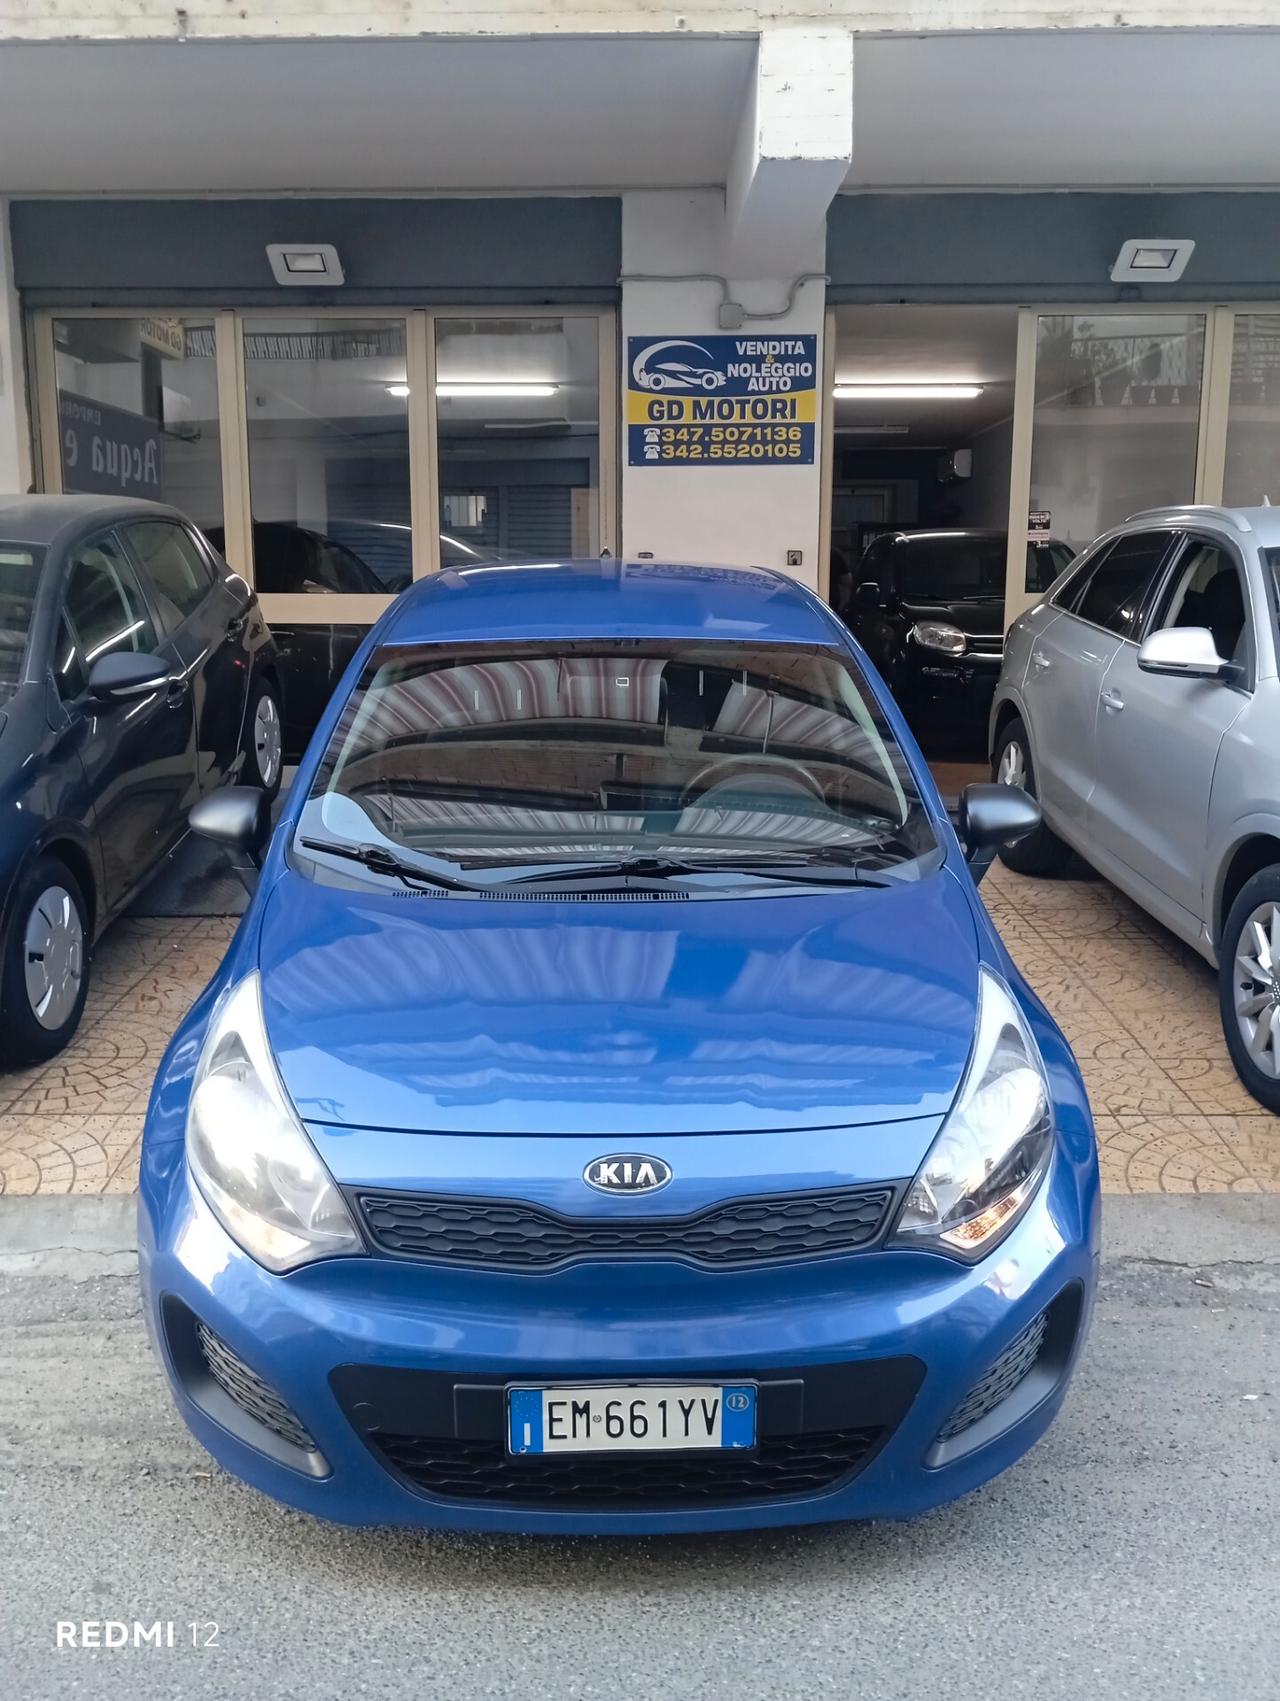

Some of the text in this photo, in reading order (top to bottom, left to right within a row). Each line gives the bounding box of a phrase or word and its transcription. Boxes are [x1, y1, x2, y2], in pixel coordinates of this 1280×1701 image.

[735, 341, 806, 356] VENDITA
[765, 354, 775, 364] &
[727, 362, 813, 378] NOLEGGIO
[747, 377, 792, 391] AUTO
[647, 398, 797, 421] GD MOTORI
[661, 427, 802, 441] 347.5071136
[661, 444, 801, 459] 342.5520105
[599, 1162, 658, 1185] KIA
[732, 1396, 745, 1408] 12
[548, 1398, 719, 1440] EM 661YV
